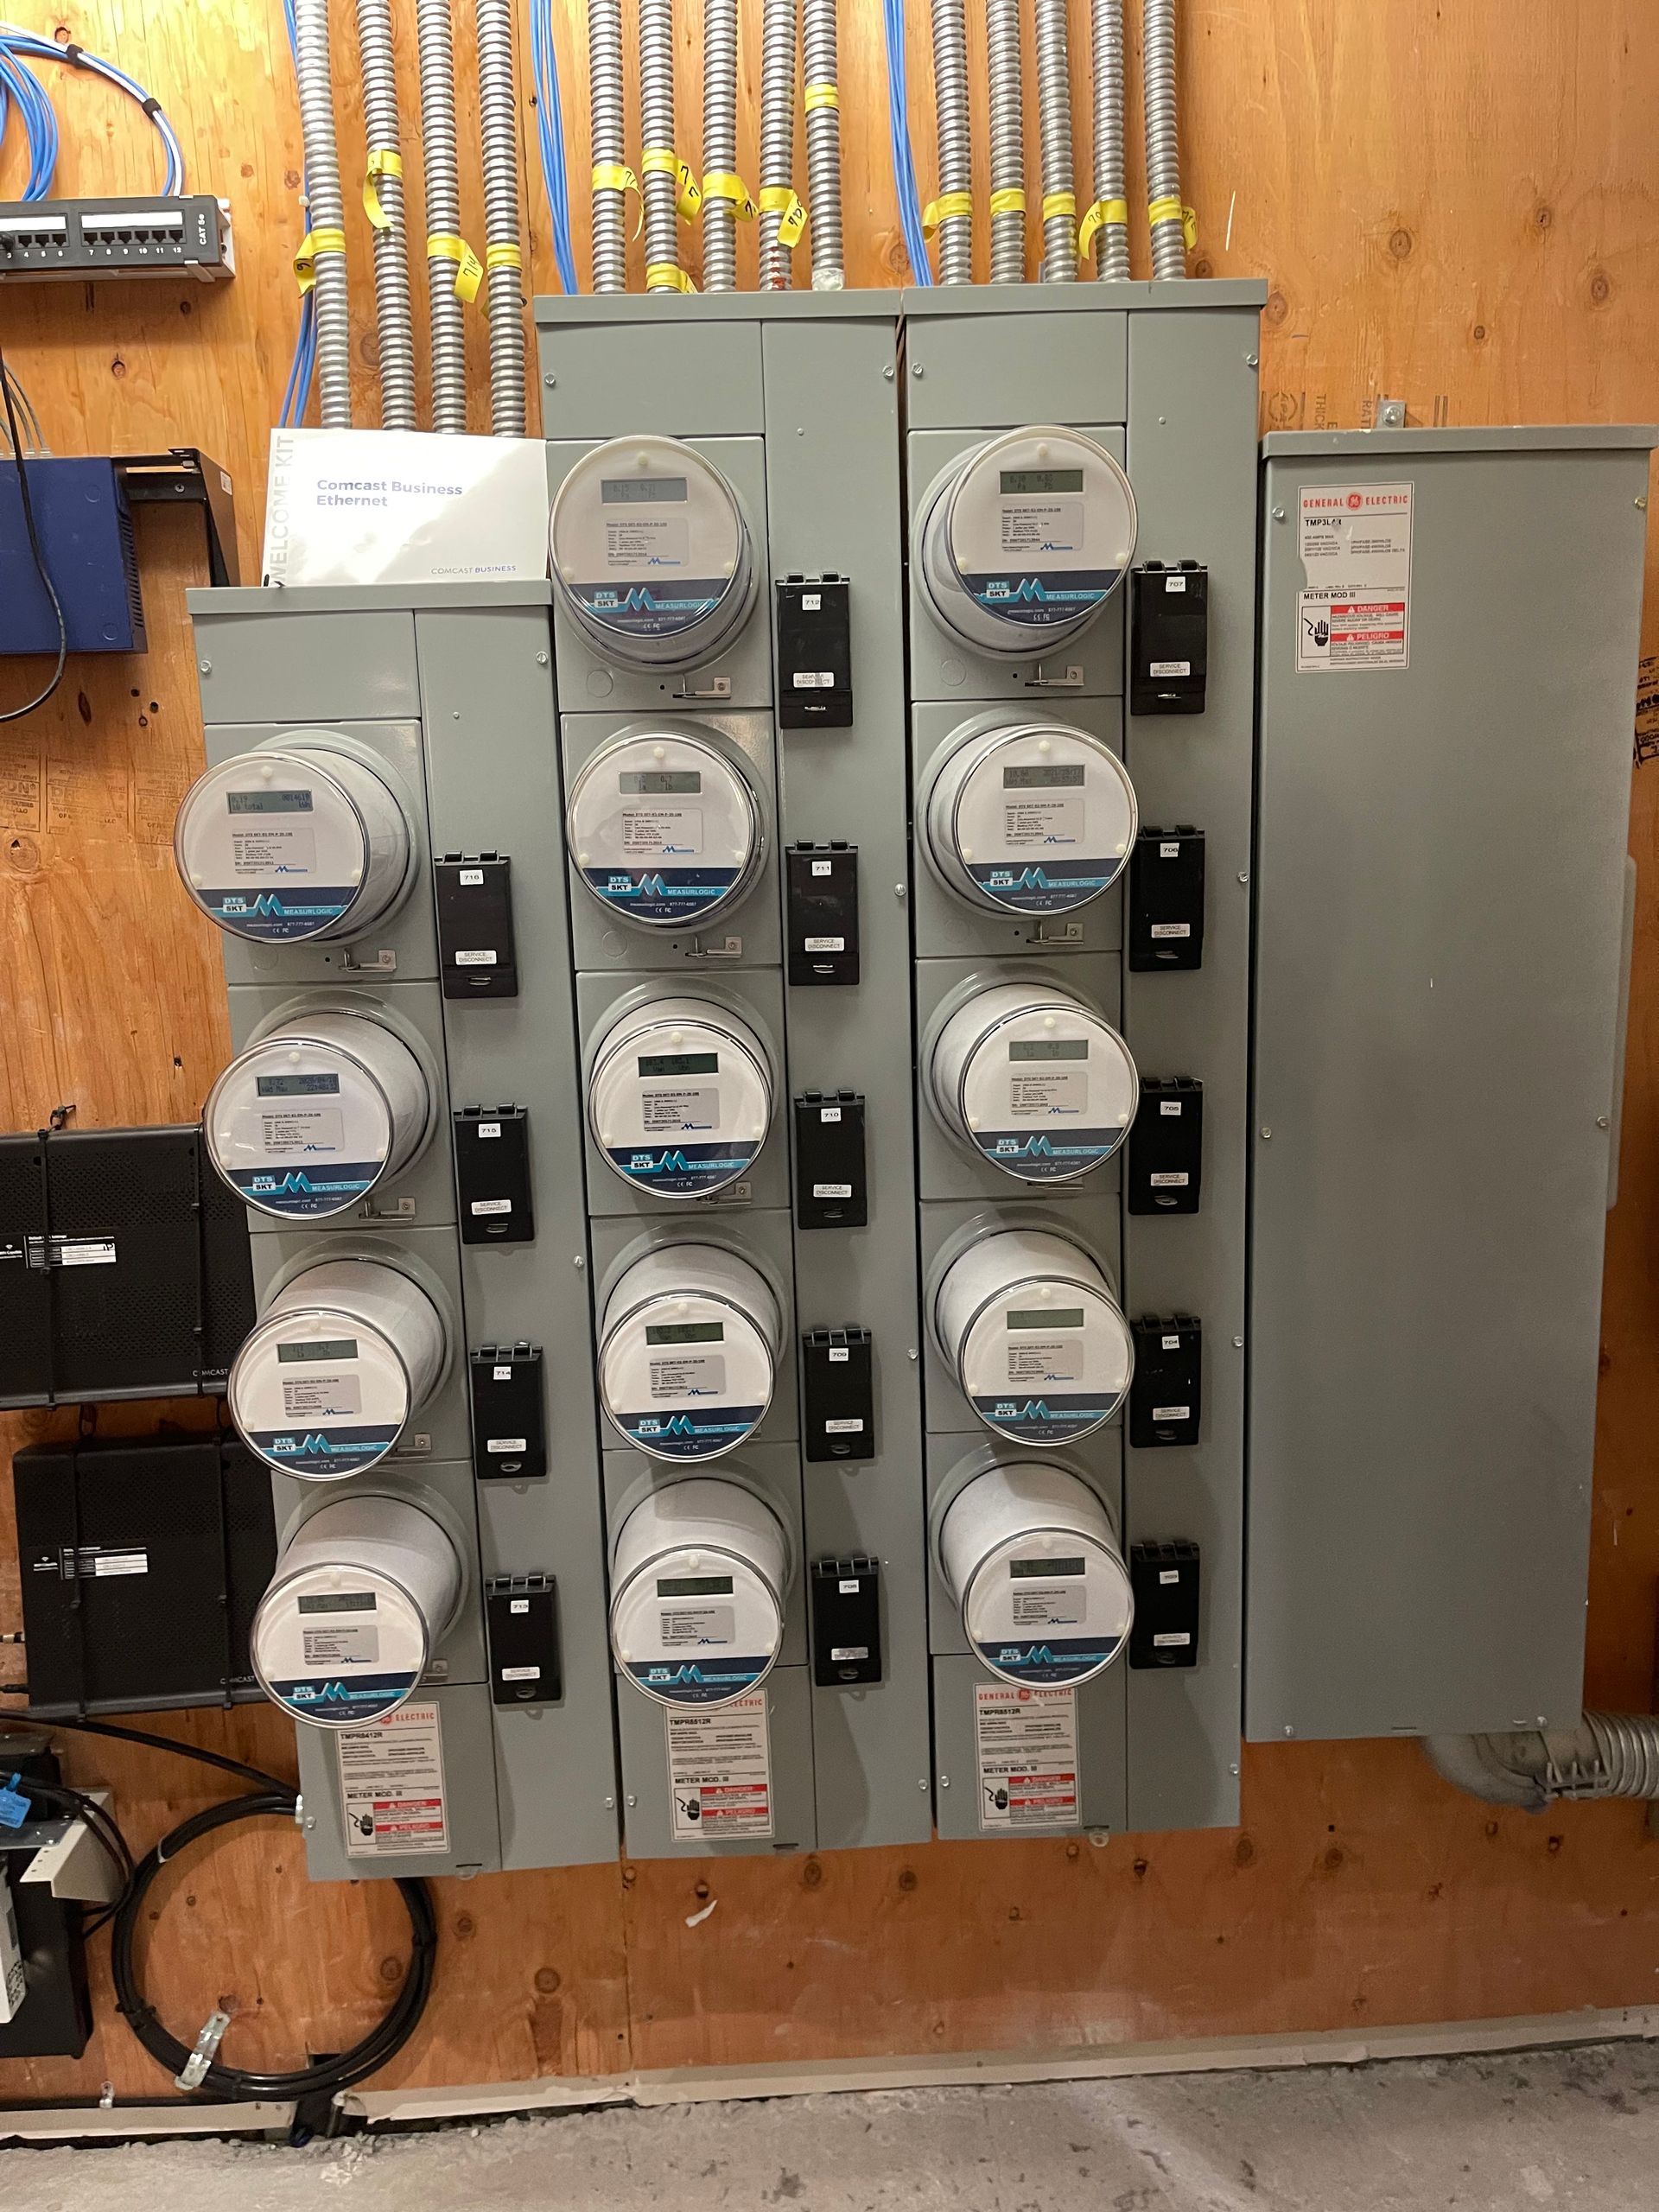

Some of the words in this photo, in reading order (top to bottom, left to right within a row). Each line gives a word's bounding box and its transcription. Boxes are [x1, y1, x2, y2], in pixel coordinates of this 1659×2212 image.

[198, 227, 207, 245] CAT
[463, 255, 479, 277] 714
[276, 436, 294, 467] KIT
[317, 480, 387, 492] Comcast
[392, 481, 462, 495] Business
[316, 495, 387, 506] Ethernet
[1303, 499, 1343, 508] GENERAL
[1366, 496, 1408, 505] ELECTRIC
[270, 476, 291, 585] WELCOME
[475, 565, 516, 574] BUSINESS
[396, 1713, 435, 1721] ELECTRIC
